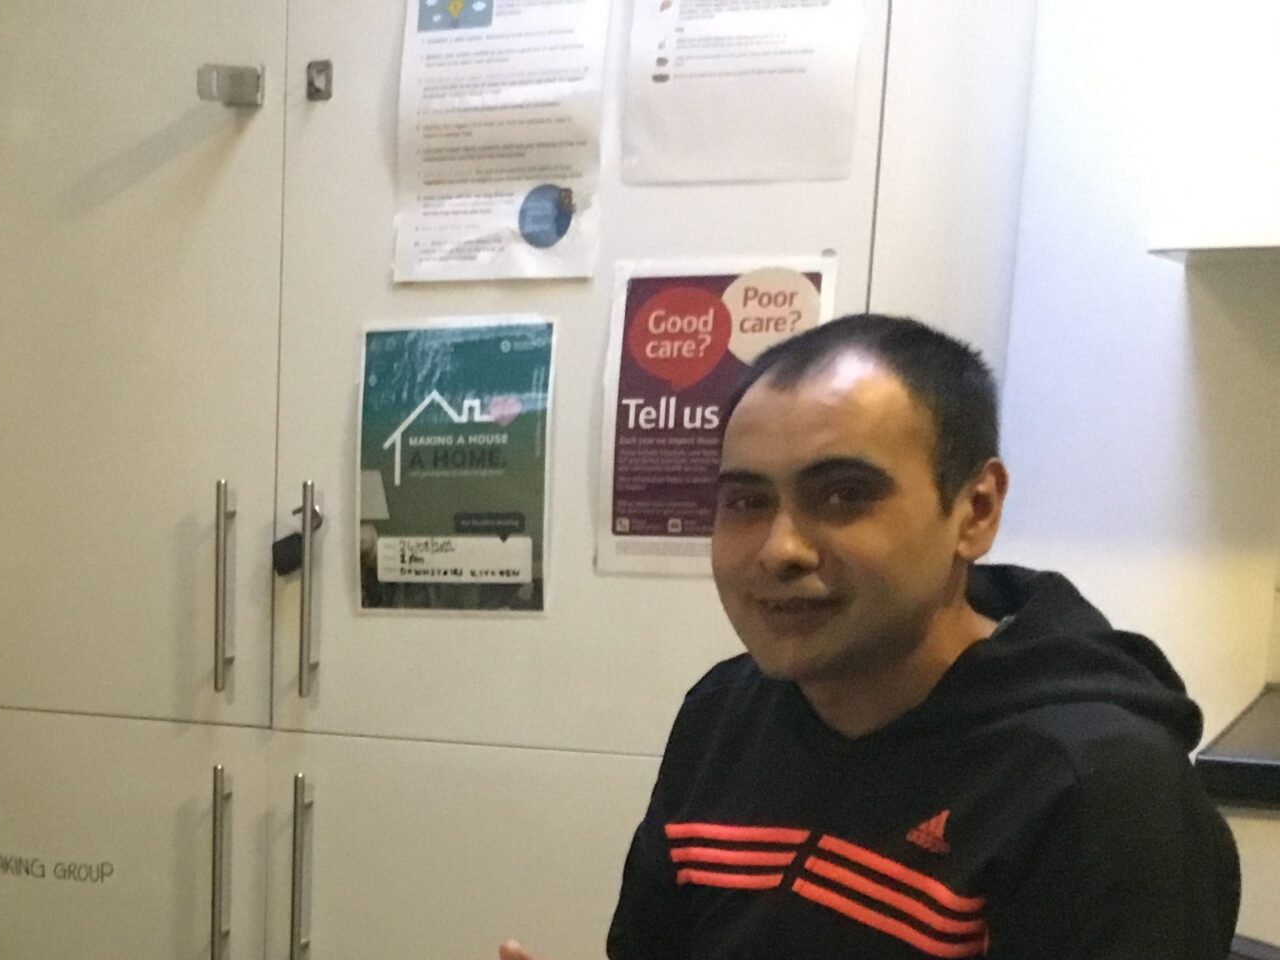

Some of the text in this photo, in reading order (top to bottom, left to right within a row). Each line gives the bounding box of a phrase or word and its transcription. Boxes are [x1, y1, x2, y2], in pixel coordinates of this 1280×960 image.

[742, 286, 799, 308] Poor
[648, 307, 714, 334] Good
[739, 311, 802, 334] care?
[645, 334, 711, 359] care?
[621, 396, 720, 430] Tell us
[408, 433, 509, 447] MAKING A HOUSE
[408, 450, 424, 469] A
[53, 861, 114, 884] GROUP
